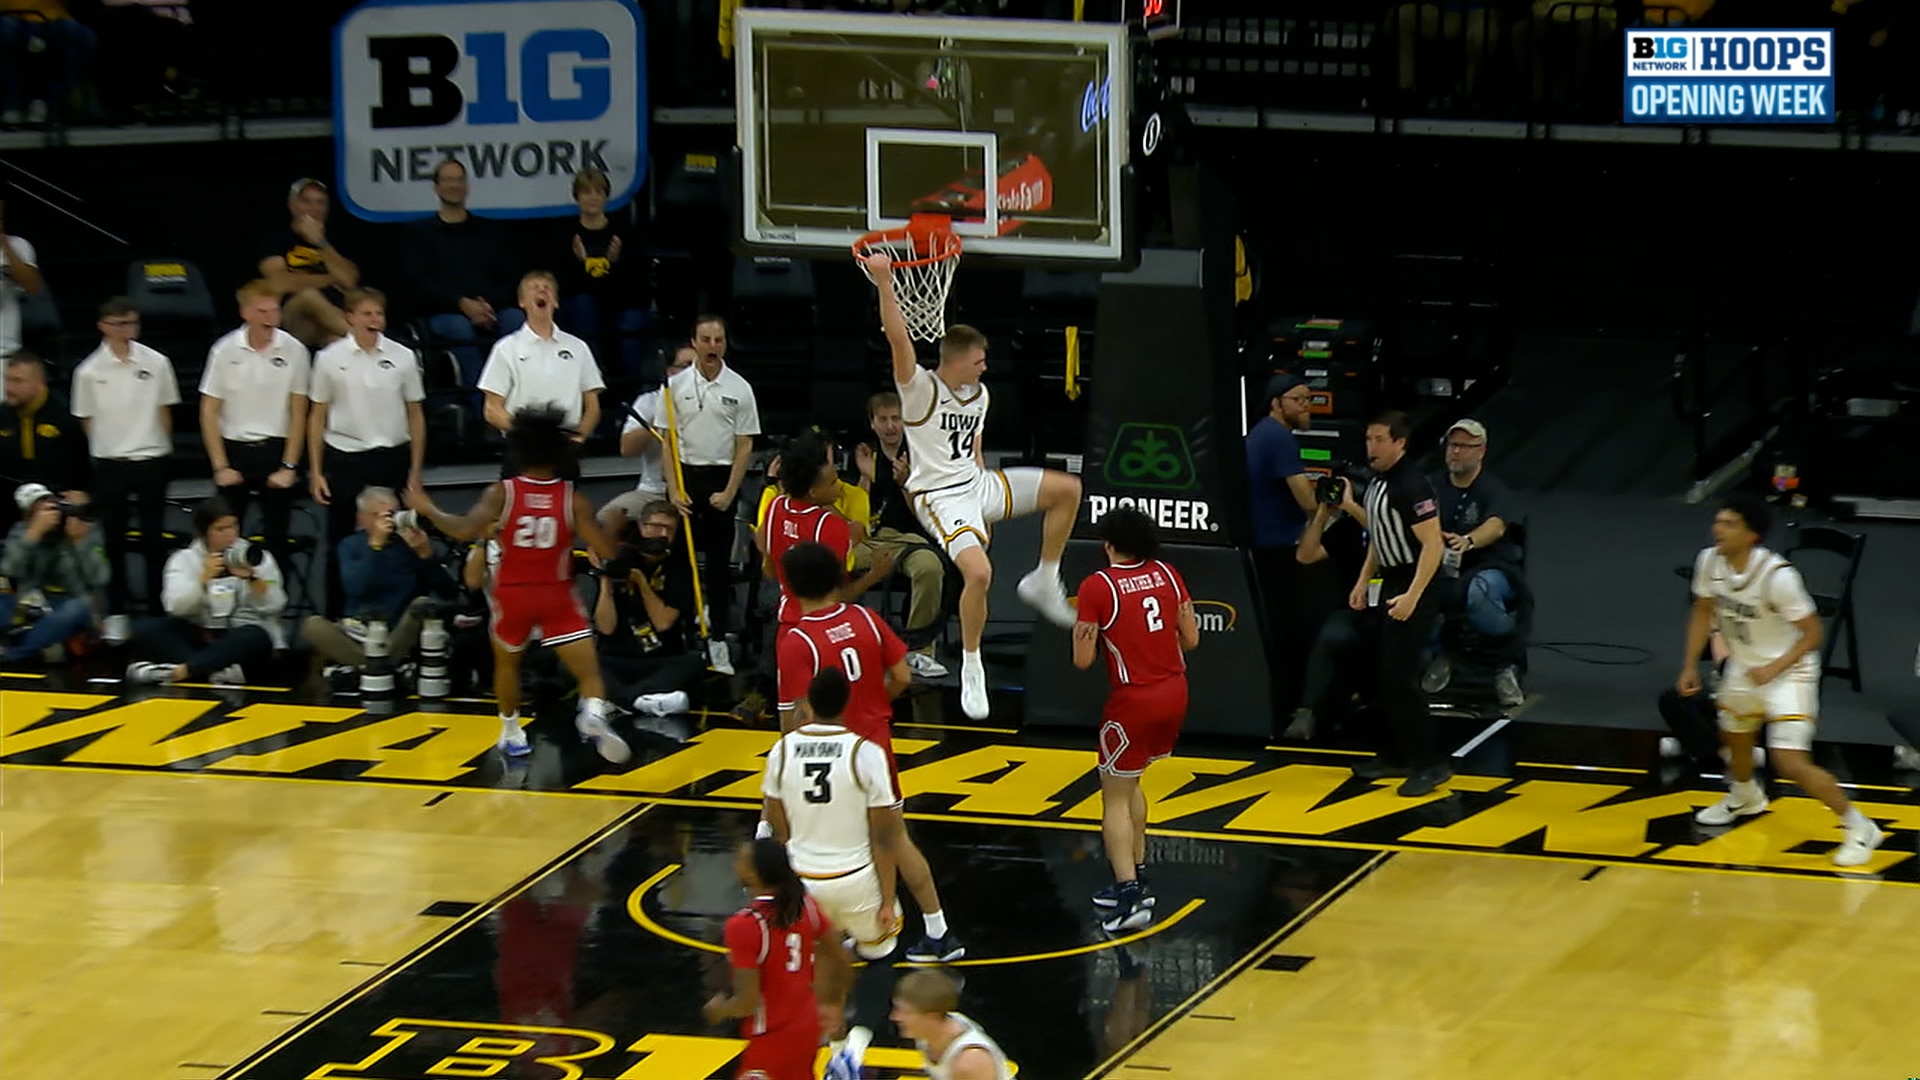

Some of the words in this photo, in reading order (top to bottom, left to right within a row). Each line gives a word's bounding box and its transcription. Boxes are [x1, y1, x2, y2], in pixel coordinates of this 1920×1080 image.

[948, 431, 975, 460] 14
[512, 515, 558, 549] 20
[1142, 596, 1164, 632] 2
[841, 646, 862, 682] 0
[804, 762, 832, 804] 3
[784, 932, 802, 973] 3
